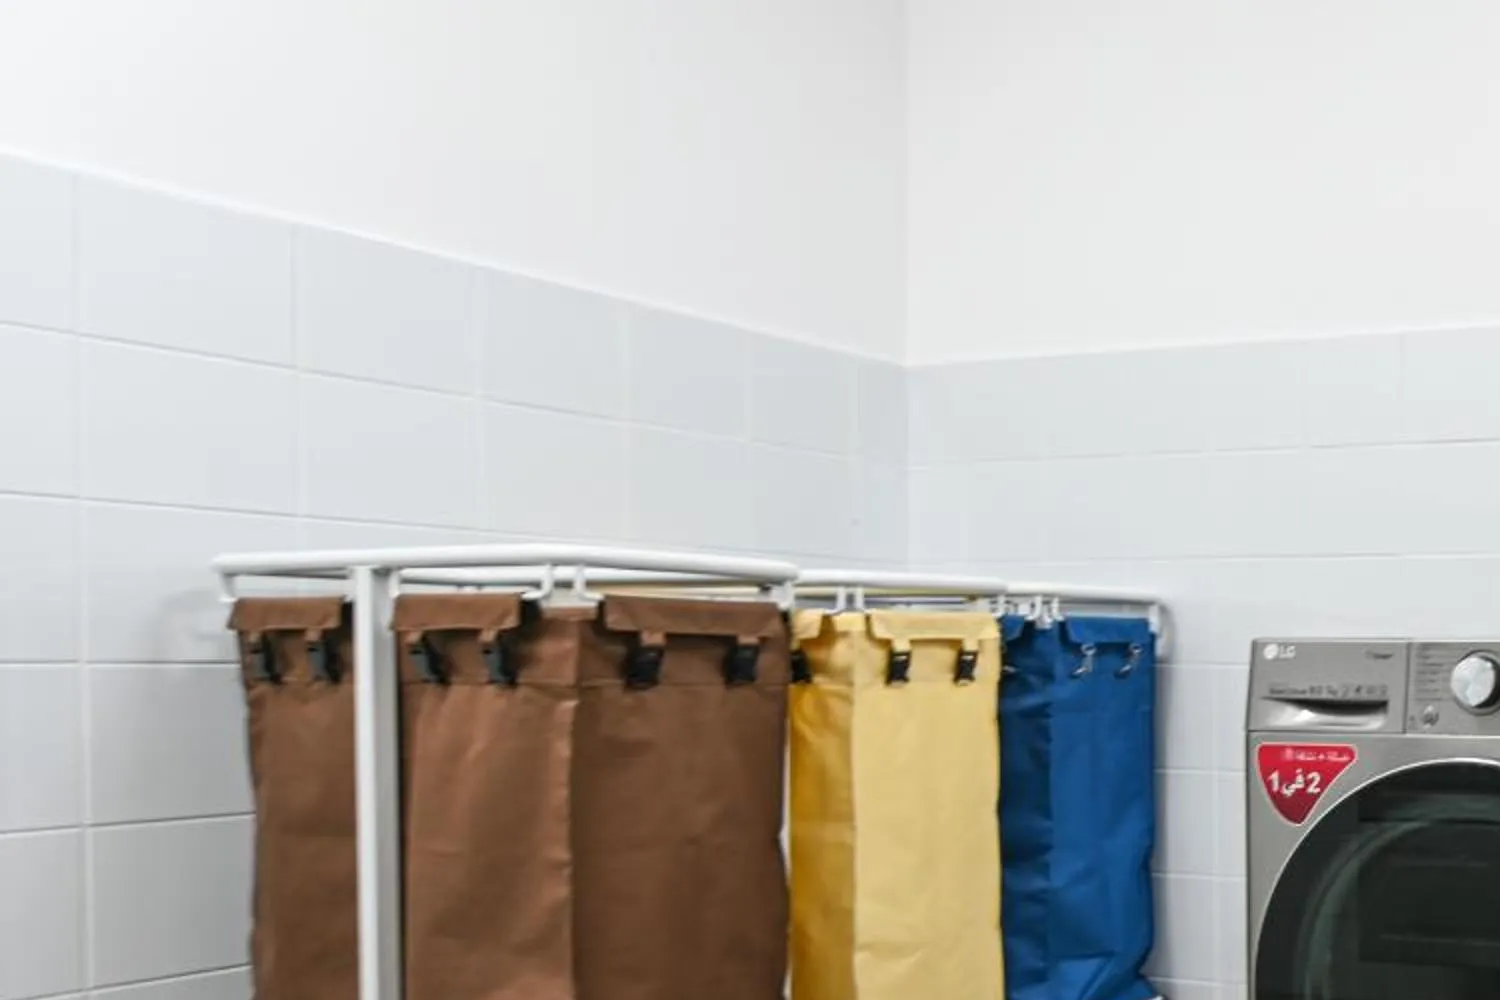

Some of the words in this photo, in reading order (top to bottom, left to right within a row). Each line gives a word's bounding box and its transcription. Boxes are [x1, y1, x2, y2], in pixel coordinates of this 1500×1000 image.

[1278, 645, 1297, 659] LG
[1266, 769, 1280, 792] 1
[1280, 767, 1305, 797] في
[1306, 771, 1321, 793] 2
